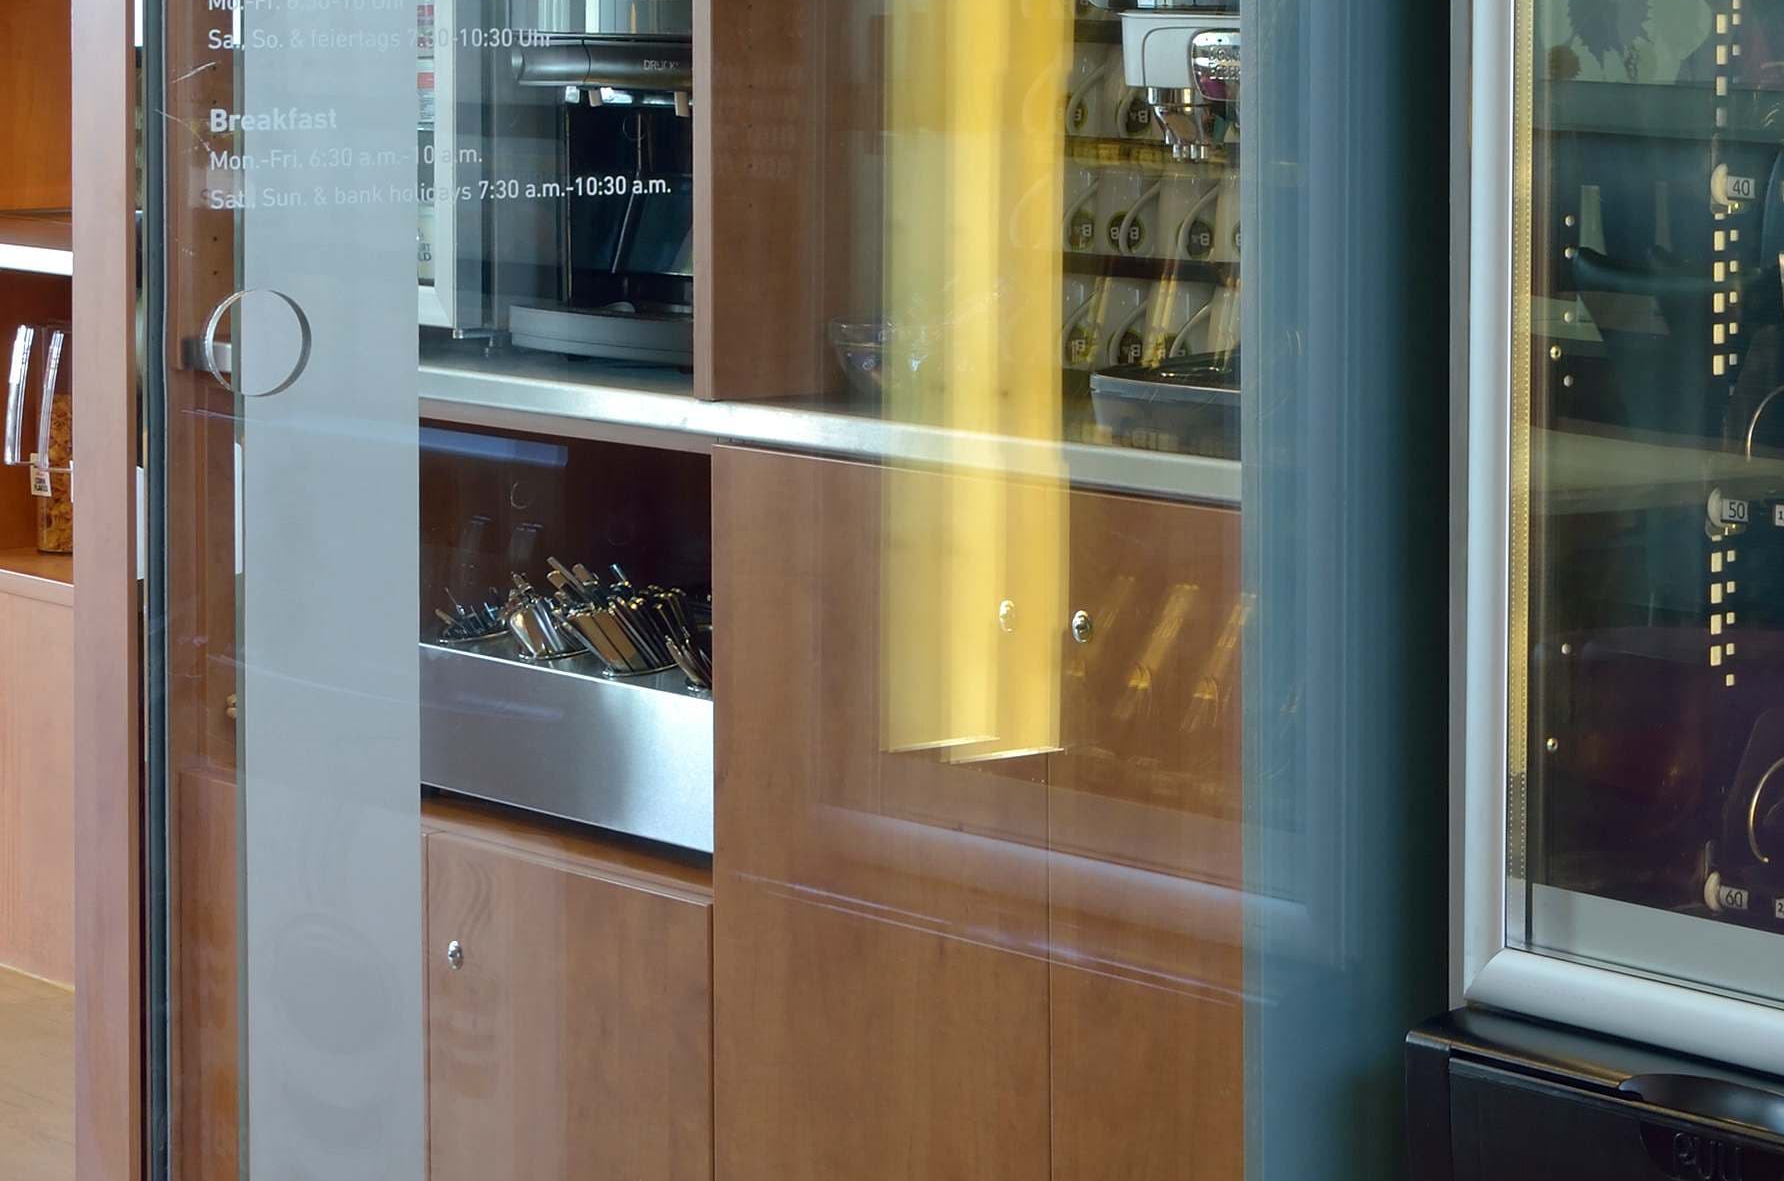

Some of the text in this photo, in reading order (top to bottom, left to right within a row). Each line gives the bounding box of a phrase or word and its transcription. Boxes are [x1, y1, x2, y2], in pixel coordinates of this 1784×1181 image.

[210, 107, 337, 132] Breakfast
[335, 184, 384, 206] bank
[389, 181, 472, 206] holidays
[478, 180, 519, 200] 7:30
[525, 176, 627, 199] a.m.-10:30
[632, 176, 672, 195] a.m.
[1732, 179, 1751, 197] 40
[1727, 502, 1745, 519] 50
[1725, 890, 1744, 907] 60
